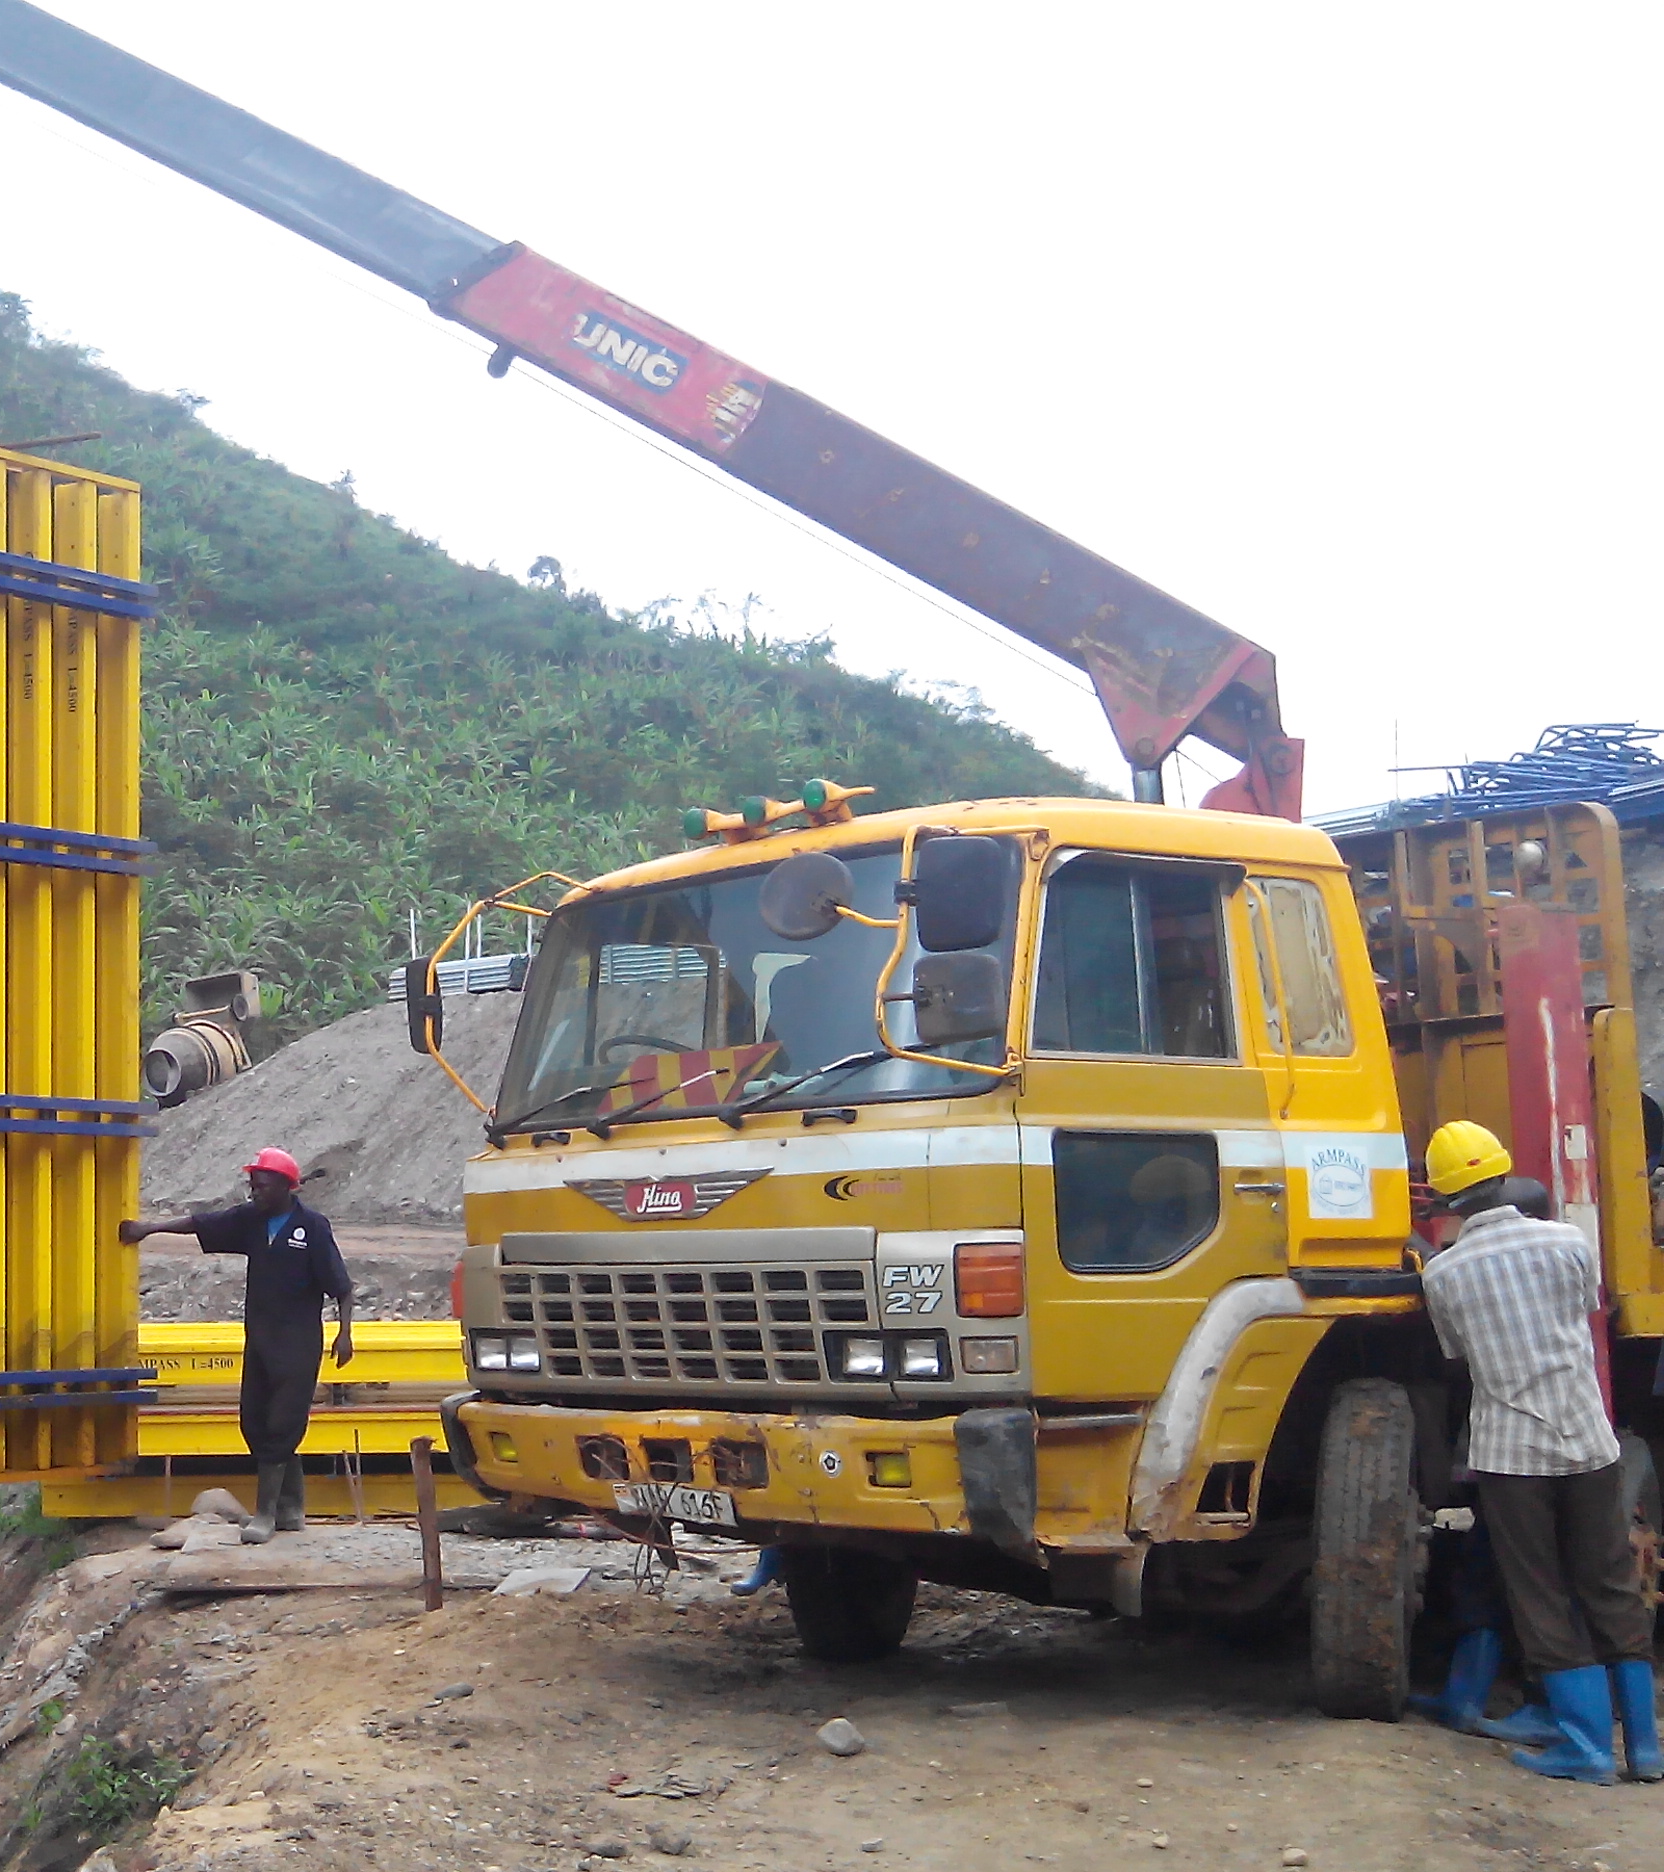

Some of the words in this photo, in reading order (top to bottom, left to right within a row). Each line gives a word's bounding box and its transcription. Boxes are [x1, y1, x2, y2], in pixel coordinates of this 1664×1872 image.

[573, 313, 678, 387] UNIC
[23, 652, 33, 700] L=4500
[67, 667, 77, 713] L=4500
[1311, 1148, 1367, 1176] ARMPASS
[882, 1265, 945, 1288] FW
[885, 1290, 943, 1314] 27
[192, 1357, 234, 1370] L=4500
